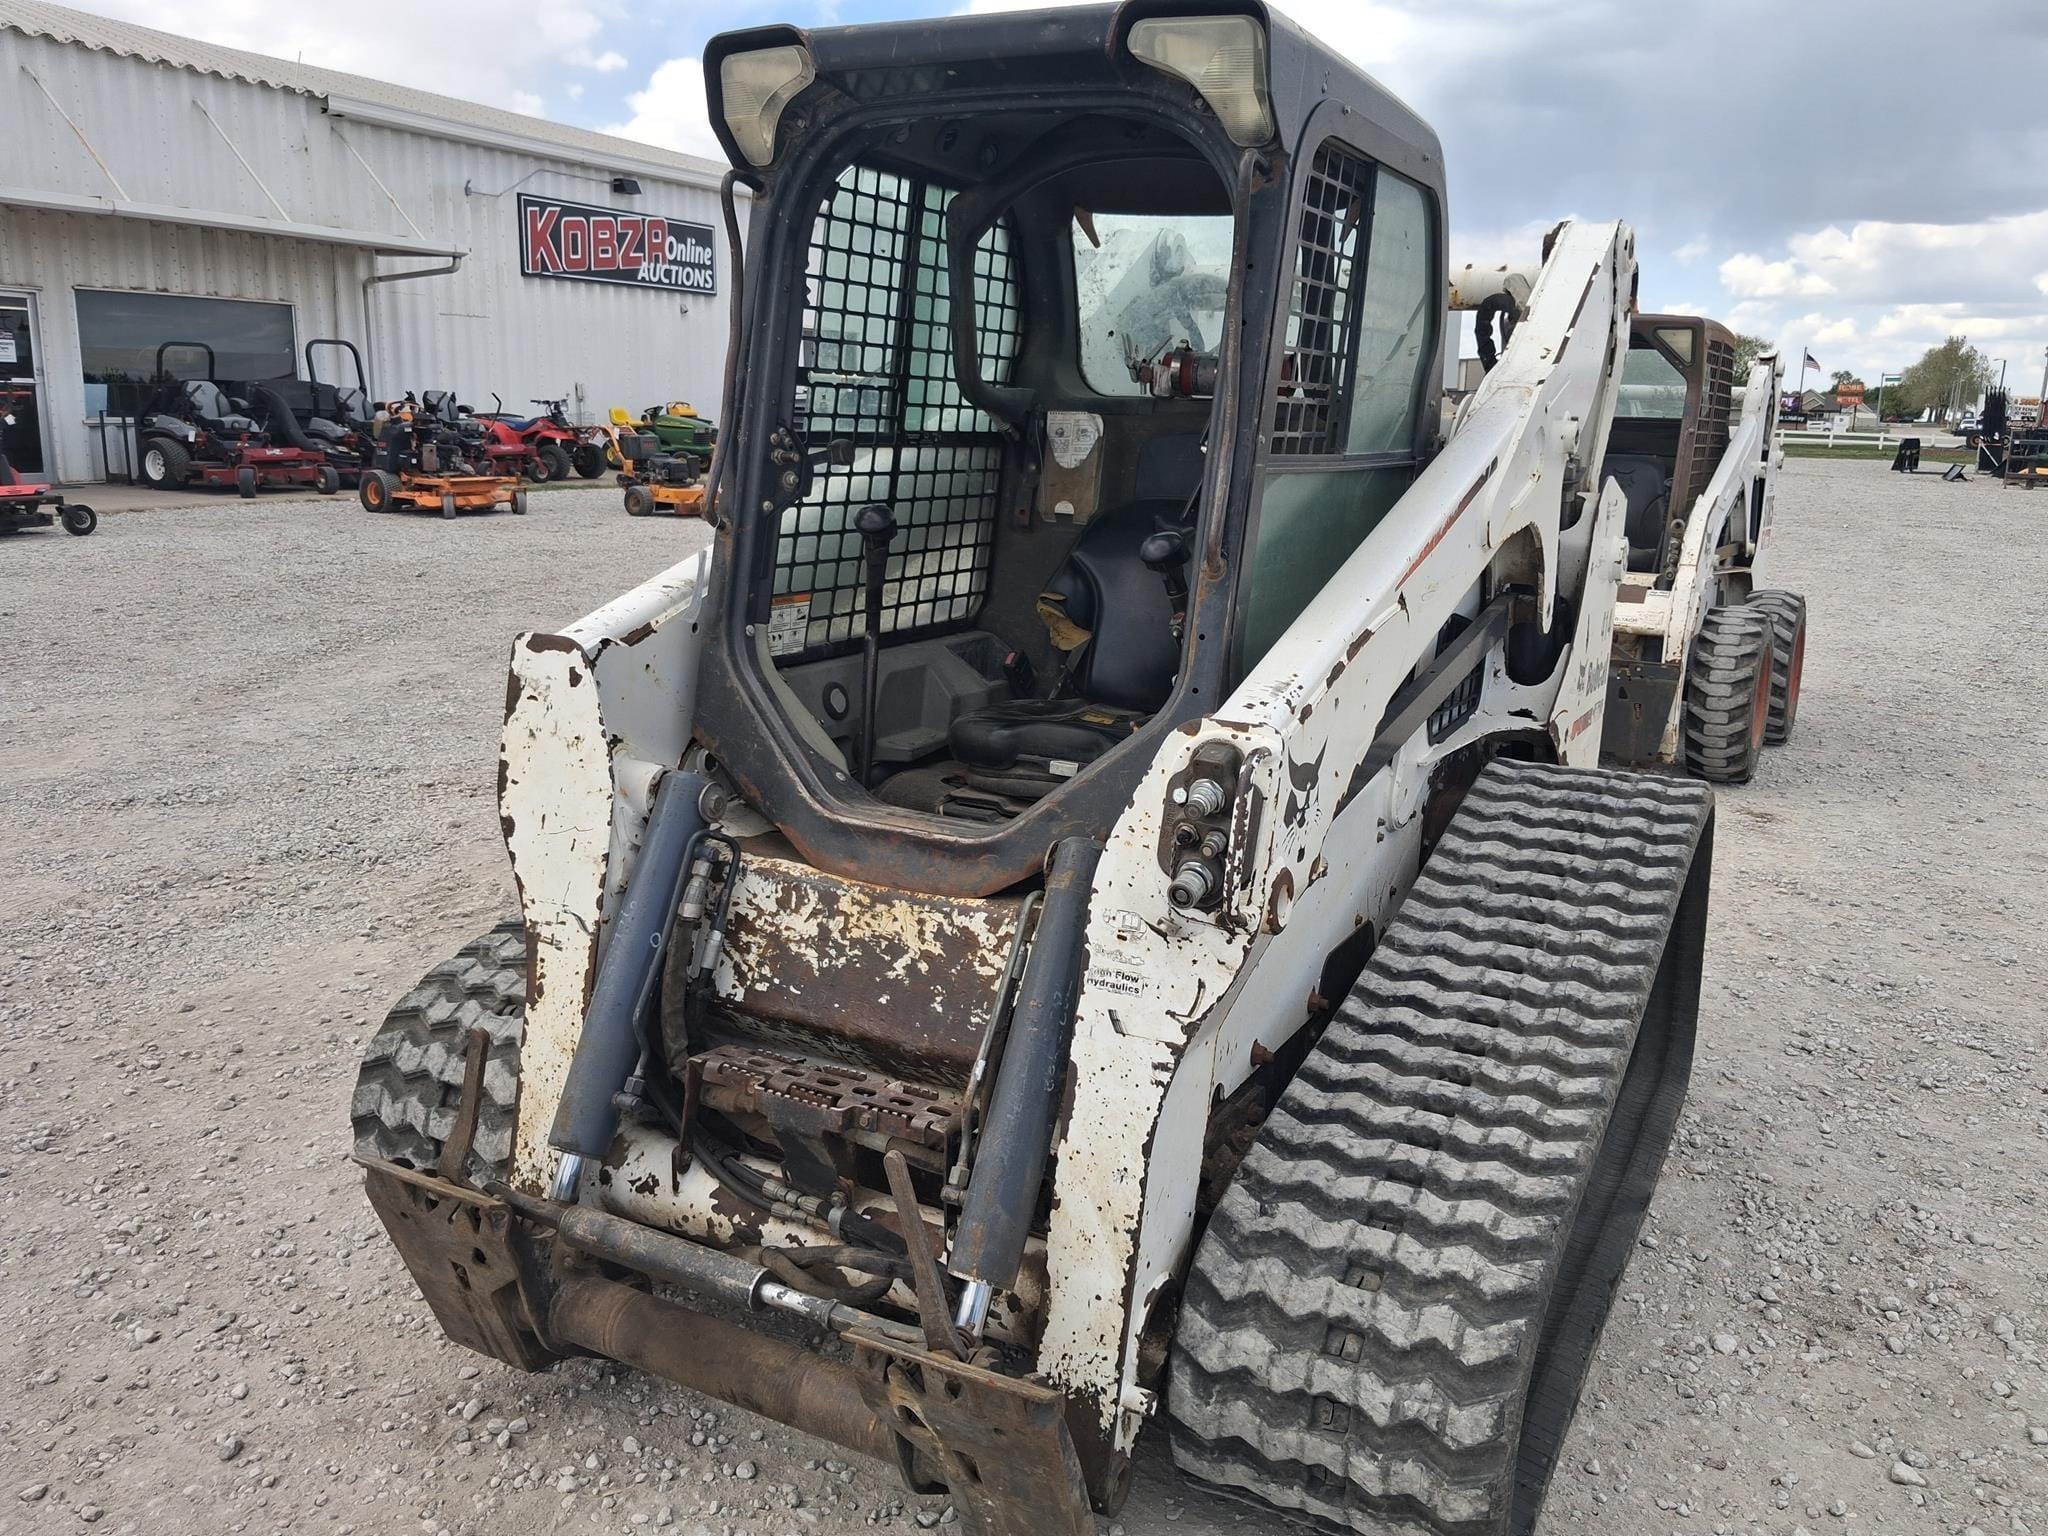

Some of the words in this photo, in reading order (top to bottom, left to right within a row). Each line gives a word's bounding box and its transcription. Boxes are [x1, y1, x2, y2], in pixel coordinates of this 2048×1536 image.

[527, 207, 668, 273] KOBZA
[665, 235, 712, 265] Online
[637, 261, 713, 289] AUCTIONS
[1115, 970, 1139, 983] Flow
